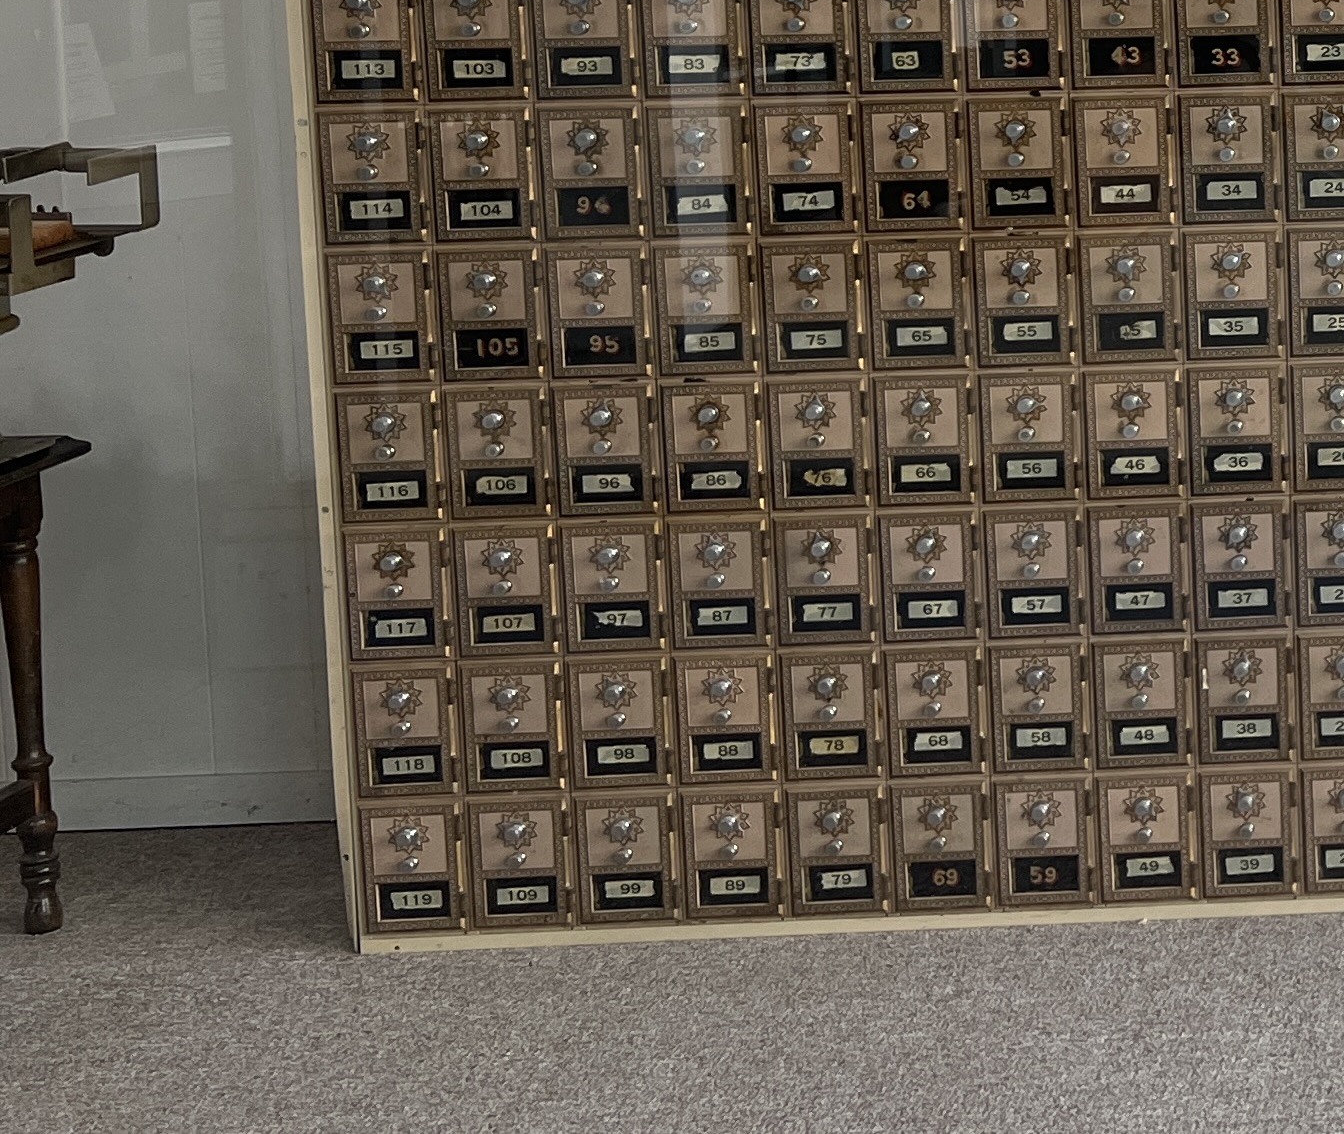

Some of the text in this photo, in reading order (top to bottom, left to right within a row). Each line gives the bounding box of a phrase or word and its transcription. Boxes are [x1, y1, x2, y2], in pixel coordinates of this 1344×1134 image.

[1210, 48, 1240, 67] 33
[1321, 46, 1341, 58] 23
[684, 58, 705, 70] 83
[790, 55, 811, 67] 73
[895, 55, 916, 67] 63
[1003, 48, 1033, 69] 53
[353, 63, 385, 76] 113
[464, 63, 495, 75] 103
[577, 61, 598, 73] 93
[1115, 188, 1136, 200] 44
[1221, 184, 1242, 196] 34
[1324, 182, 1344, 194] 24
[798, 195, 819, 207] 74
[901, 190, 932, 211] 64
[1010, 190, 1031, 201] 54
[361, 203, 393, 215] 114
[471, 204, 502, 216] 104
[691, 198, 712, 211] 84
[1017, 326, 1037, 337] 55
[1223, 321, 1244, 333] 35
[699, 336, 720, 348] 85
[805, 334, 827, 346] 75
[911, 330, 932, 342] 65
[372, 344, 403, 356] 115
[476, 337, 519, 359] 105
[589, 334, 620, 354] 95
[1125, 459, 1145, 471] 46
[1228, 456, 1249, 468] 36
[916, 467, 936, 479] 66
[1021, 463, 1042, 475] 56
[486, 479, 516, 491] 106
[599, 478, 620, 490] 96
[705, 474, 727, 487] 86
[377, 485, 409, 498] 116
[1130, 594, 1150, 606] 47
[1232, 593, 1252, 604] 37
[923, 603, 943, 615] 67
[1026, 599, 1046, 611] 57
[712, 610, 732, 622] 87
[817, 606, 838, 618] 77
[493, 618, 524, 629] 107
[607, 613, 627, 625] 97
[386, 621, 417, 634] 117
[1236, 722, 1257, 734] 38
[928, 735, 948, 747] 68
[1031, 731, 1052, 743] 58
[1134, 729, 1155, 741] 48
[718, 745, 739, 757] 88
[824, 740, 844, 751] 78
[501, 752, 532, 765] 108
[614, 748, 635, 760] 98
[394, 759, 425, 772] 118
[1139, 860, 1160, 872] 49
[1240, 858, 1260, 870] 39
[831, 873, 852, 885] 79
[931, 869, 960, 887] 69
[1030, 865, 1058, 885] 59
[620, 883, 641, 895] 99
[725, 879, 746, 891] 89
[401, 893, 433, 906] 119
[507, 889, 538, 902] 109
